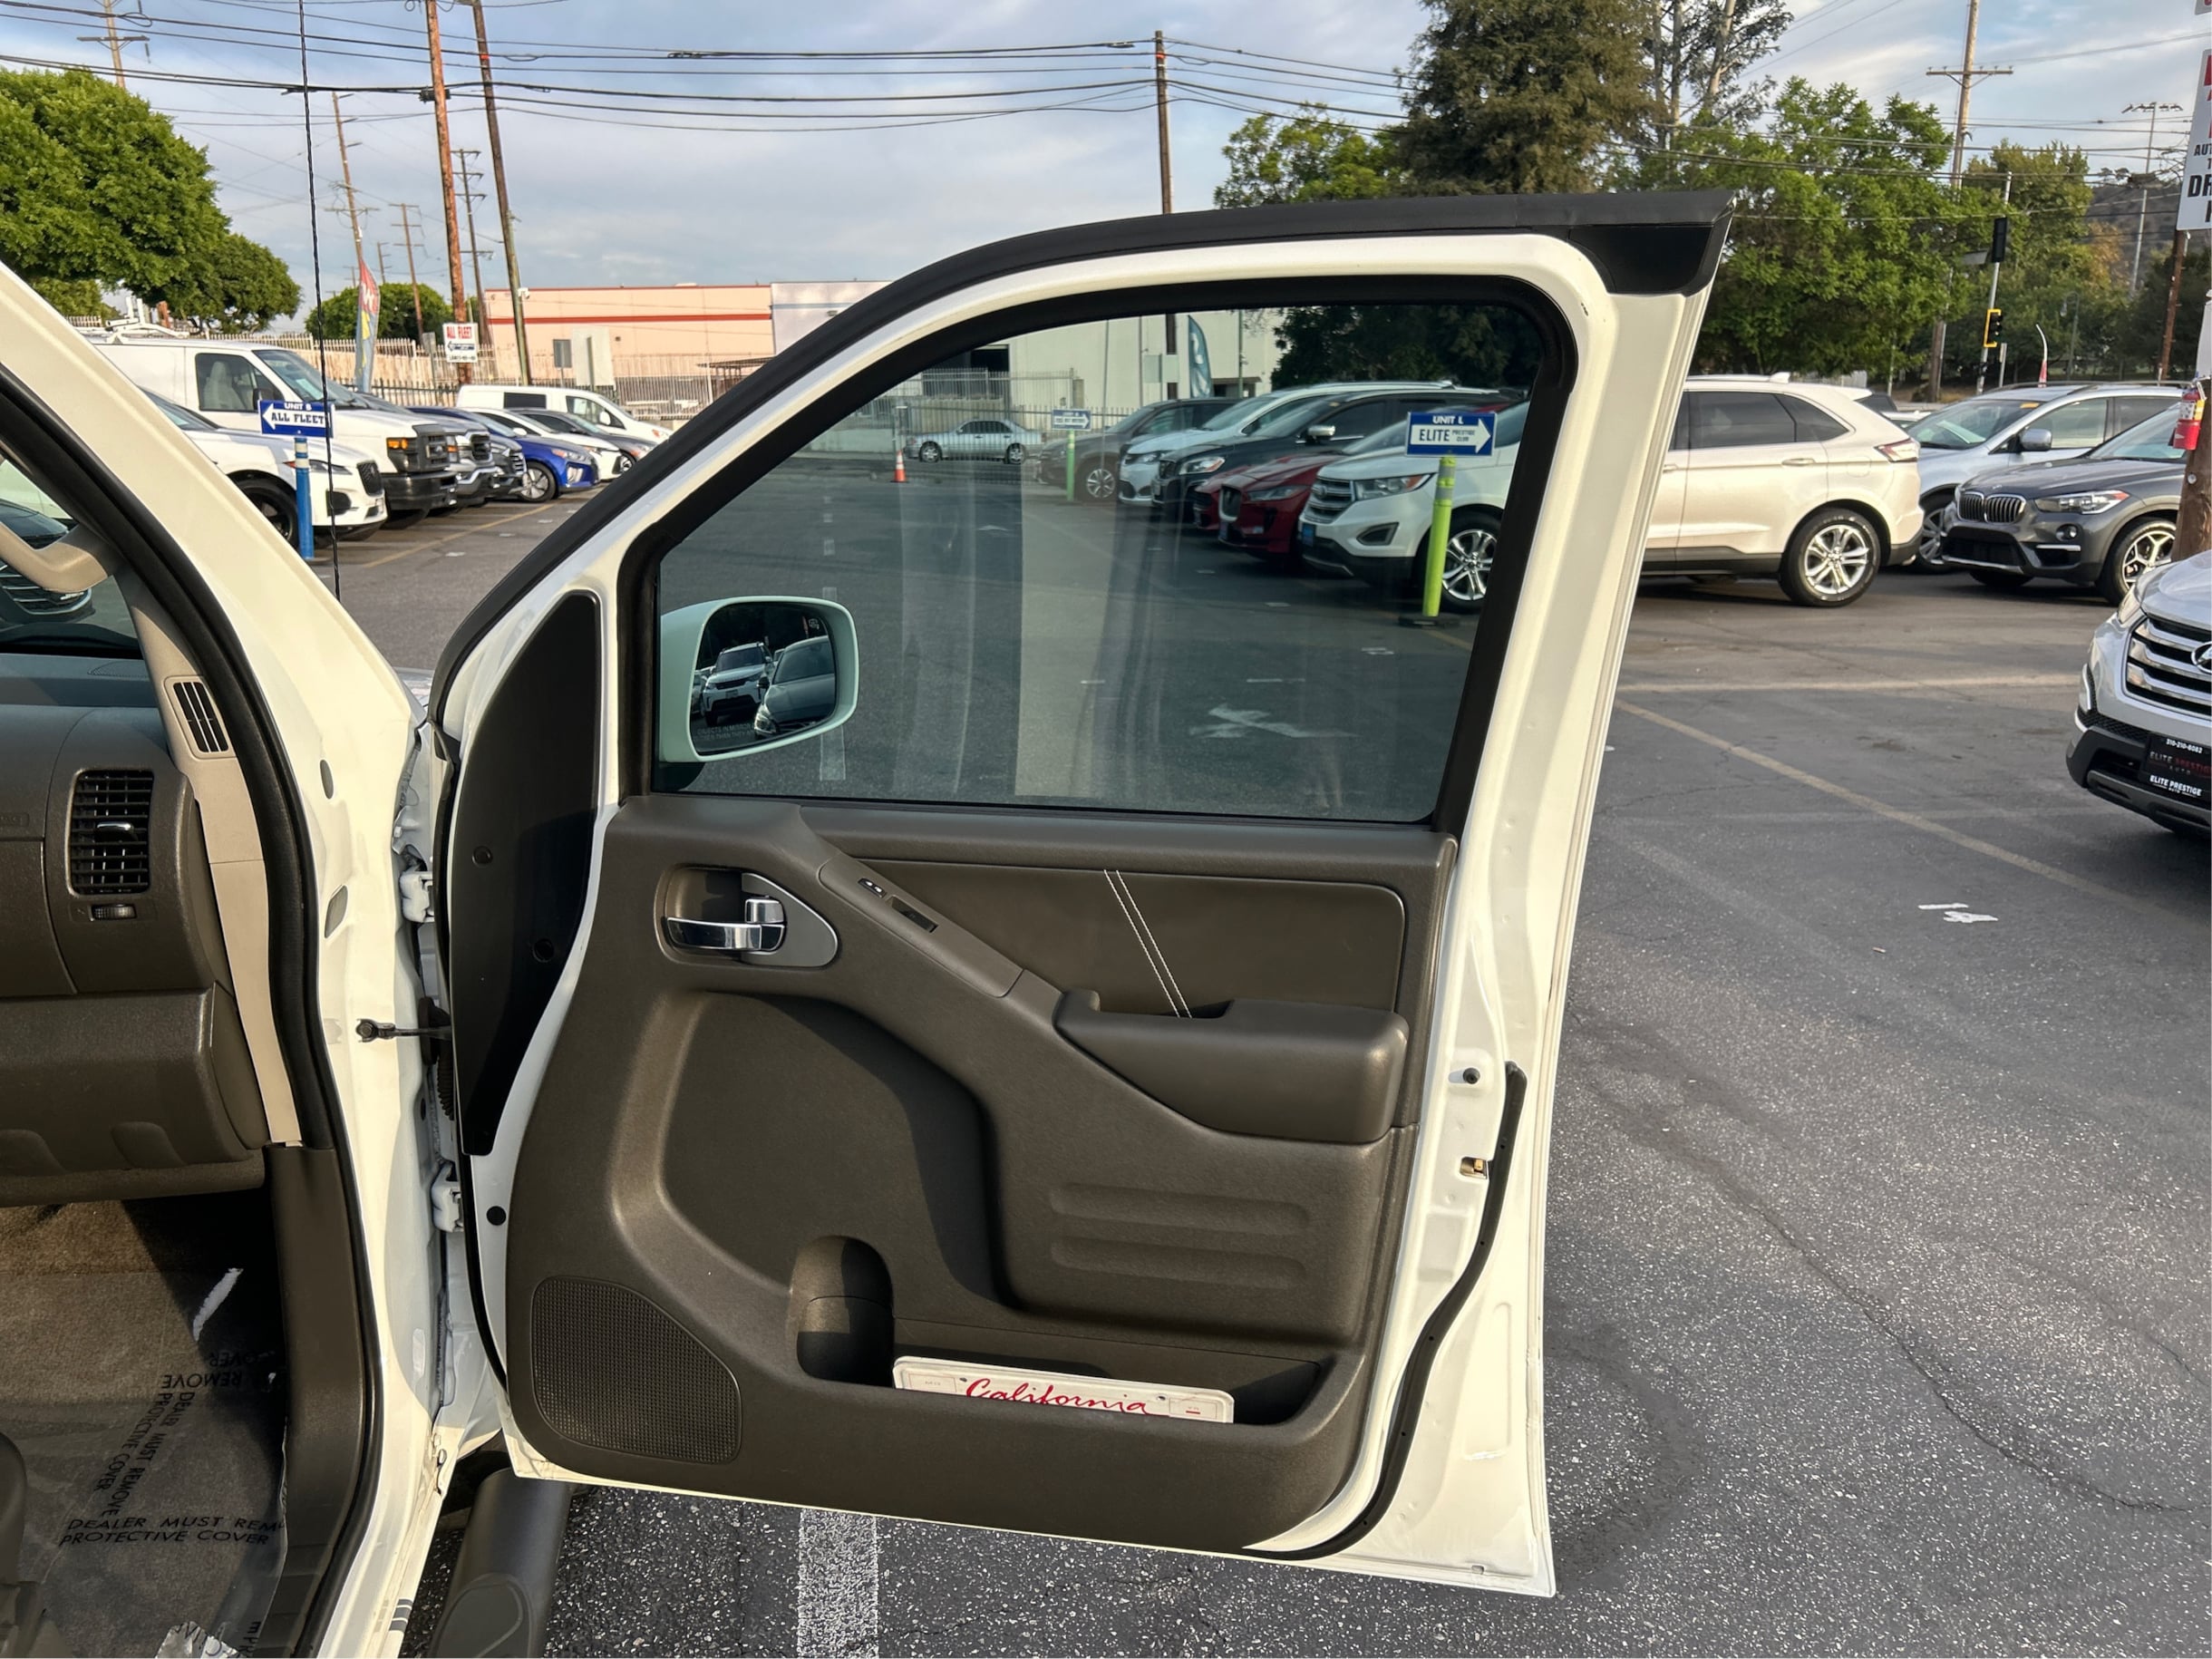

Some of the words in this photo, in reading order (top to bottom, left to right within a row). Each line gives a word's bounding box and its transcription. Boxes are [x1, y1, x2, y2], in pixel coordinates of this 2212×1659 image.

[284, 402, 304, 411] UNIT
[271, 412, 290, 422] ALL
[294, 413, 324, 425] FLEET
[1432, 415, 1455, 424] UNIT
[1419, 429, 1450, 441] ELITE
[2149, 752, 2173, 762] ELITE
[2175, 757, 2210, 774] PRESTIG
[2149, 774, 2168, 786] ELITE
[2169, 781, 2202, 796] PRESTIGE
[161, 1371, 242, 1388] REMOVE
[966, 1378, 1155, 1416] California
[160, 1392, 195, 1426] DEALER
[122, 1392, 173, 1449] PROTECTIVE
[136, 1433, 167, 1460] MUST
[93, 1453, 130, 1491] COVER
[100, 1468, 145, 1517] REMOVE
[67, 1517, 147, 1530] DEALER
[160, 1517, 224, 1528] MUST
[60, 1530, 188, 1545] PROTECTIVE
[197, 1529, 269, 1545] COVER
